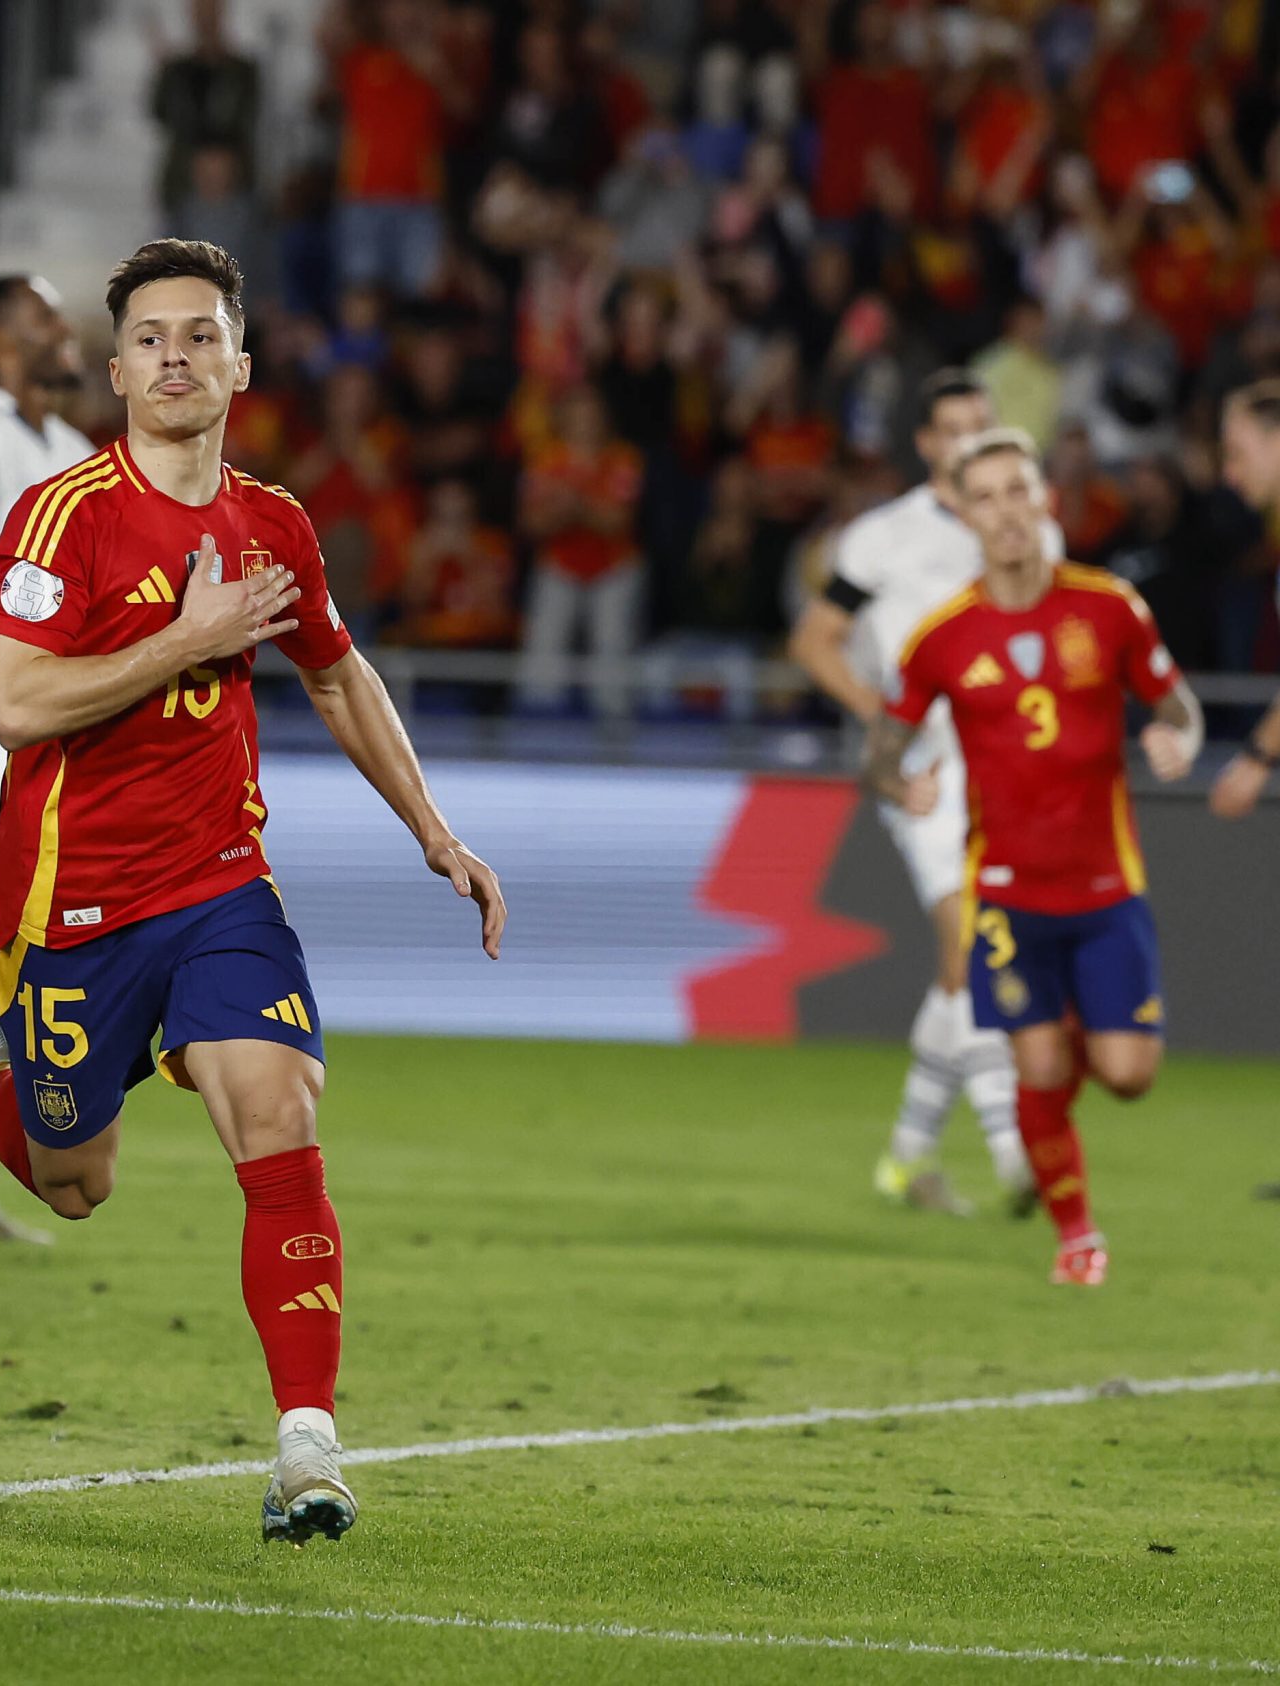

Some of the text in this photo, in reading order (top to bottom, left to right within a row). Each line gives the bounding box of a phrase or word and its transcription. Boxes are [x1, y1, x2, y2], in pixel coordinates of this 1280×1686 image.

[1016, 685, 1060, 750] 3
[977, 909, 1016, 968] 3
[18, 981, 89, 1069] 15
